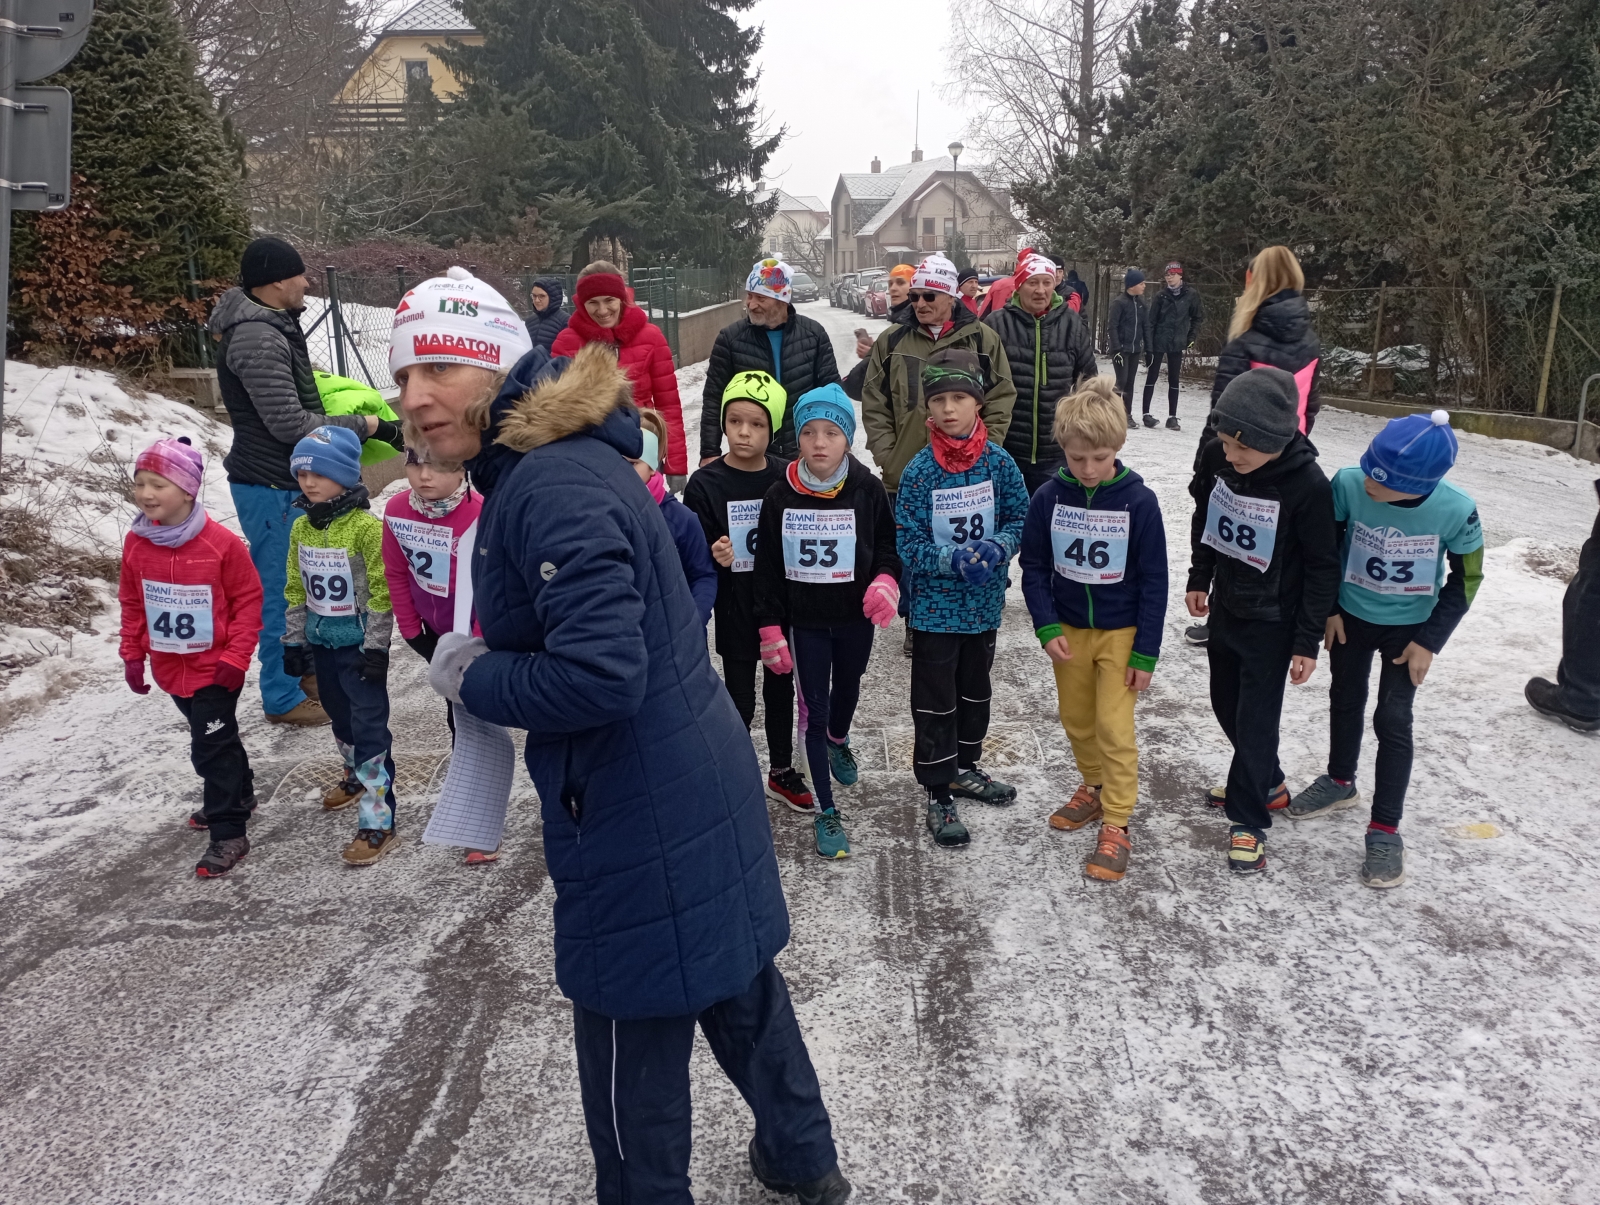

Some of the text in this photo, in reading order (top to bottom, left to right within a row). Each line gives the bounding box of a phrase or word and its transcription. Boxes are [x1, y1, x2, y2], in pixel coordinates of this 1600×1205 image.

[438, 298, 479, 317] LES
[413, 334, 500, 357] MARATON
[478, 353, 498, 363] stav
[935, 490, 963, 502] ZIMNÍ
[977, 495, 992, 505] LIGA
[786, 512, 815, 523] ZIMNÍ
[1056, 508, 1086, 521] ZIMNÍ
[1249, 512, 1274, 523] LIGA
[785, 522, 828, 531] BĚŽECKÁ
[949, 513, 984, 545] 38
[1054, 518, 1126, 533] BĚŽECKÁ LIGA
[1218, 515, 1257, 551] 68
[427, 538, 449, 548] LIGA
[798, 539, 838, 568] 53
[1064, 538, 1110, 569] 46
[1366, 556, 1415, 583] 63
[145, 583, 172, 596] ZIMNÍ
[153, 611, 196, 639] 48
